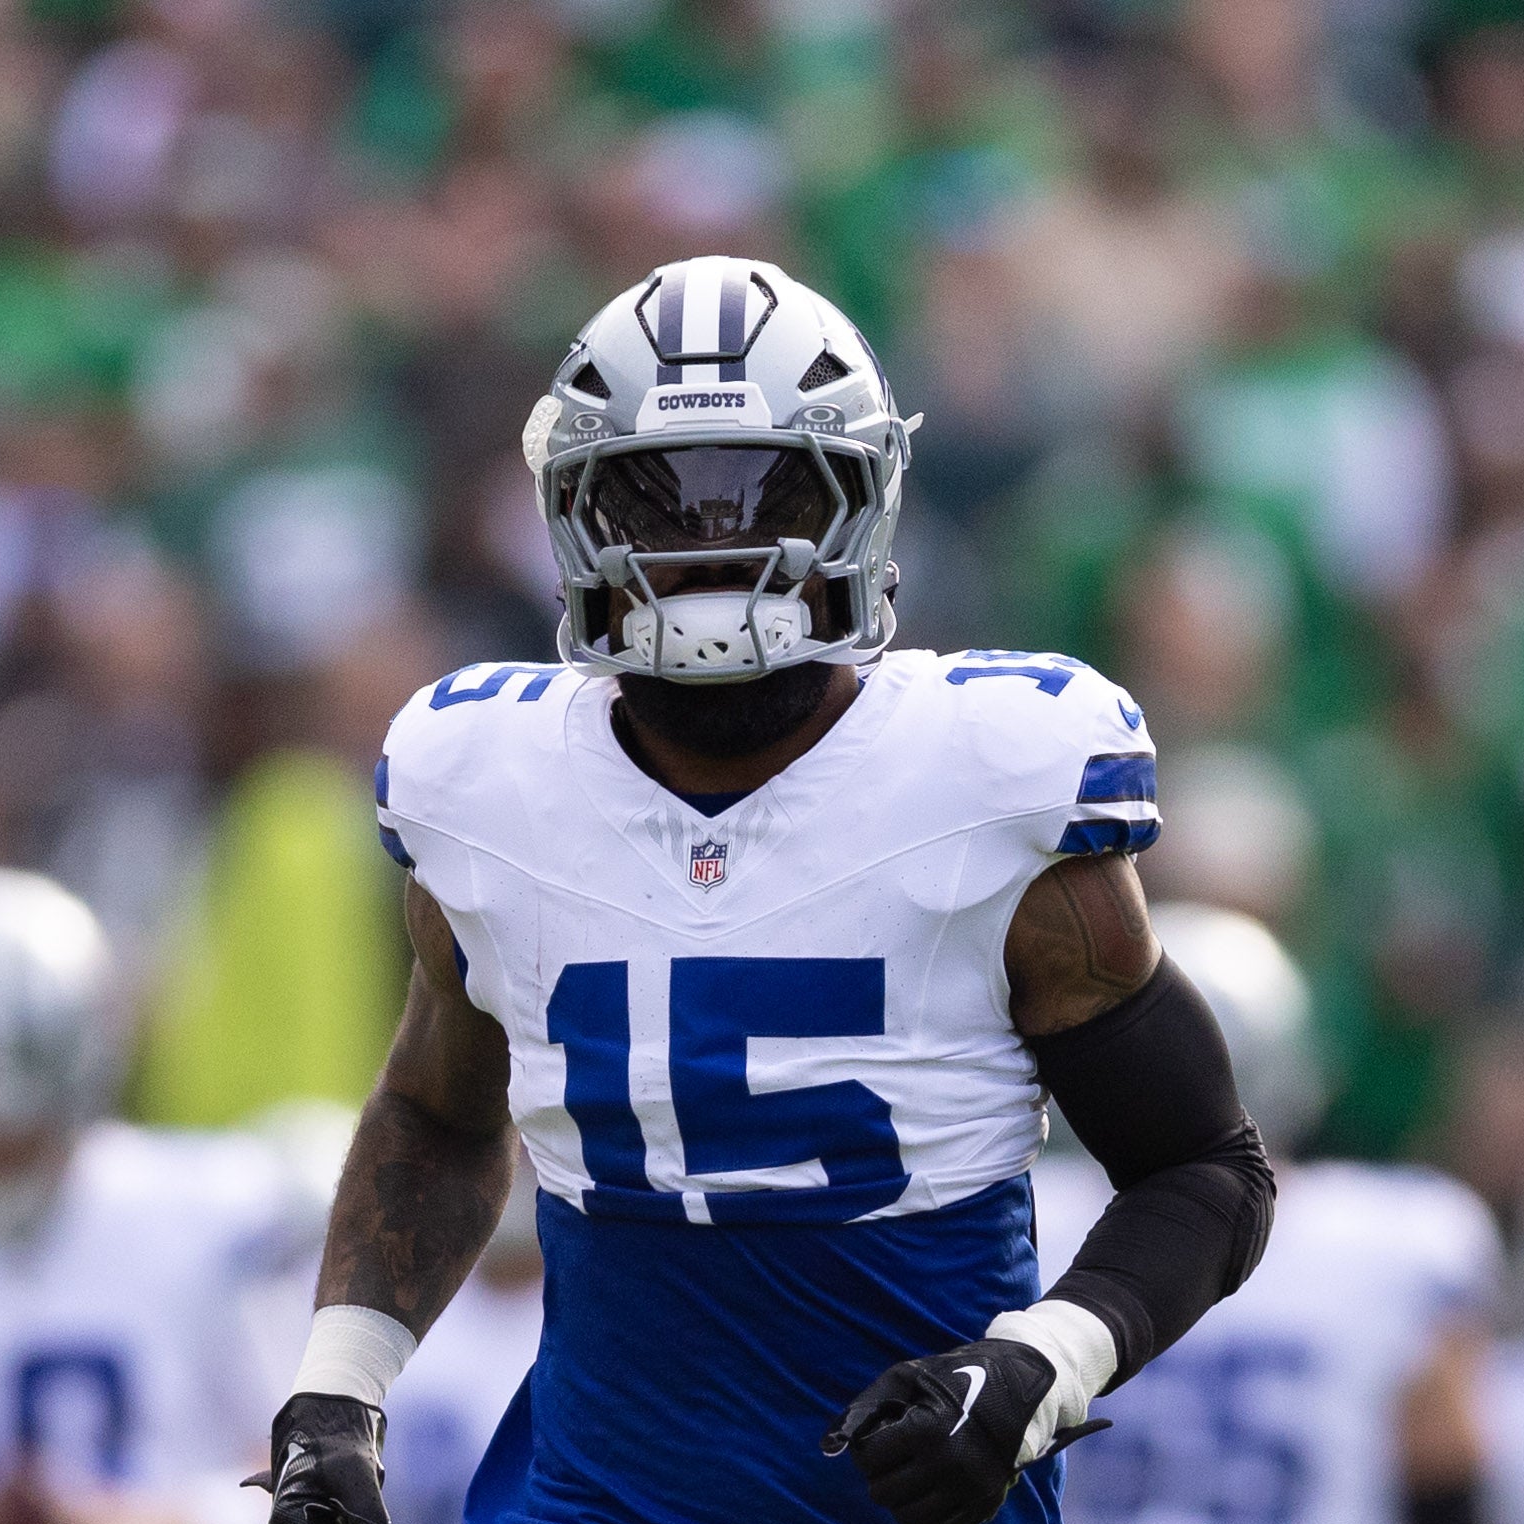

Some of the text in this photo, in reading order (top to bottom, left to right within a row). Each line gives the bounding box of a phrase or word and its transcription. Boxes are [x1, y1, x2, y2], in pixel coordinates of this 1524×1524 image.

[658, 392, 746, 411] COWBOYS
[570, 431, 610, 441] OAKLEY
[795, 423, 843, 431] OAKLEY
[693, 860, 722, 882] NFL
[546, 956, 913, 1226] 15
